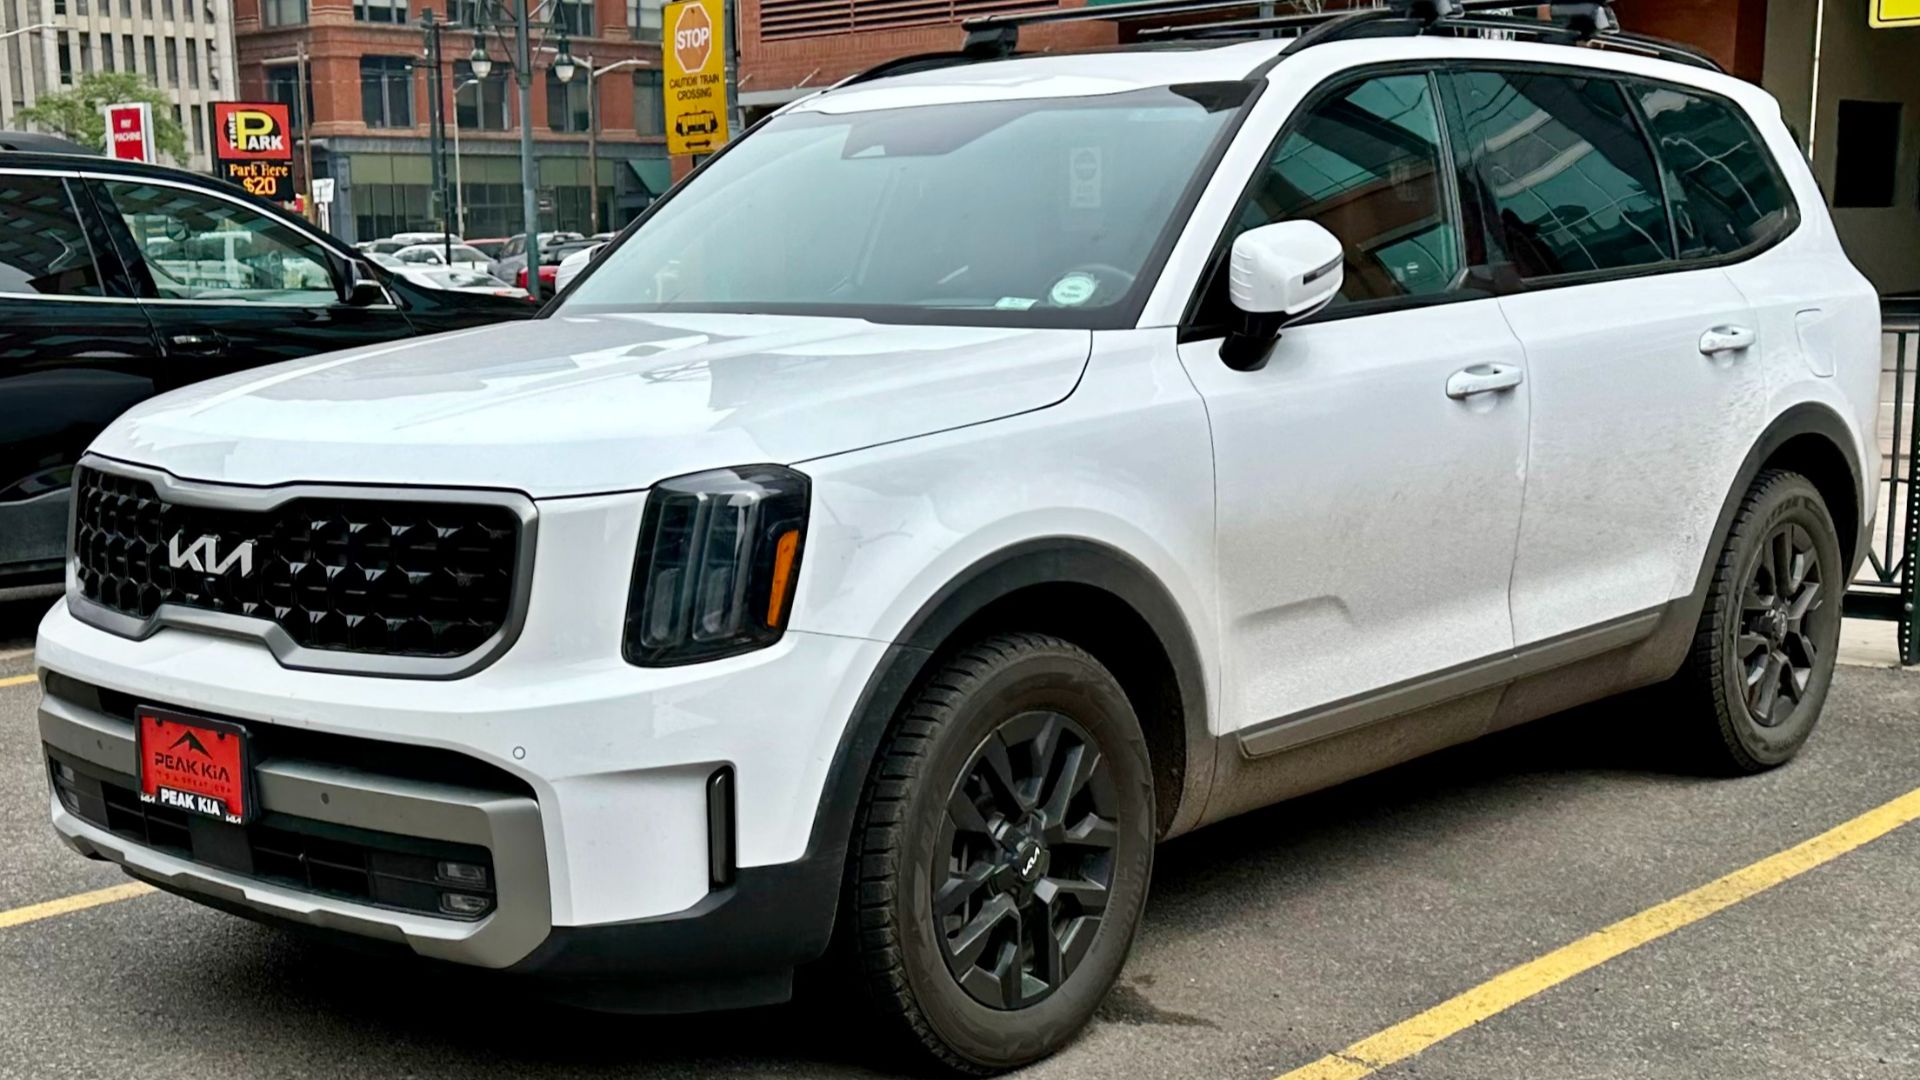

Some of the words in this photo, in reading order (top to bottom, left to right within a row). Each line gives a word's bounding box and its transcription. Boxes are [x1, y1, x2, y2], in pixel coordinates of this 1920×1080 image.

[677, 27, 709, 49] STOP
[669, 76, 698, 89] CAUTION
[700, 74, 719, 85] TRAIN
[677, 88, 712, 101] CROSSING
[227, 111, 238, 150] TIME
[235, 110, 284, 150] PARK
[229, 163, 257, 177] Park
[261, 164, 288, 177] Here
[243, 177, 276, 195] $20
[169, 529, 258, 578] KIA
[155, 752, 199, 776] PEAK
[160, 788, 195, 810] PEAK
[198, 797, 220, 816] KIA
